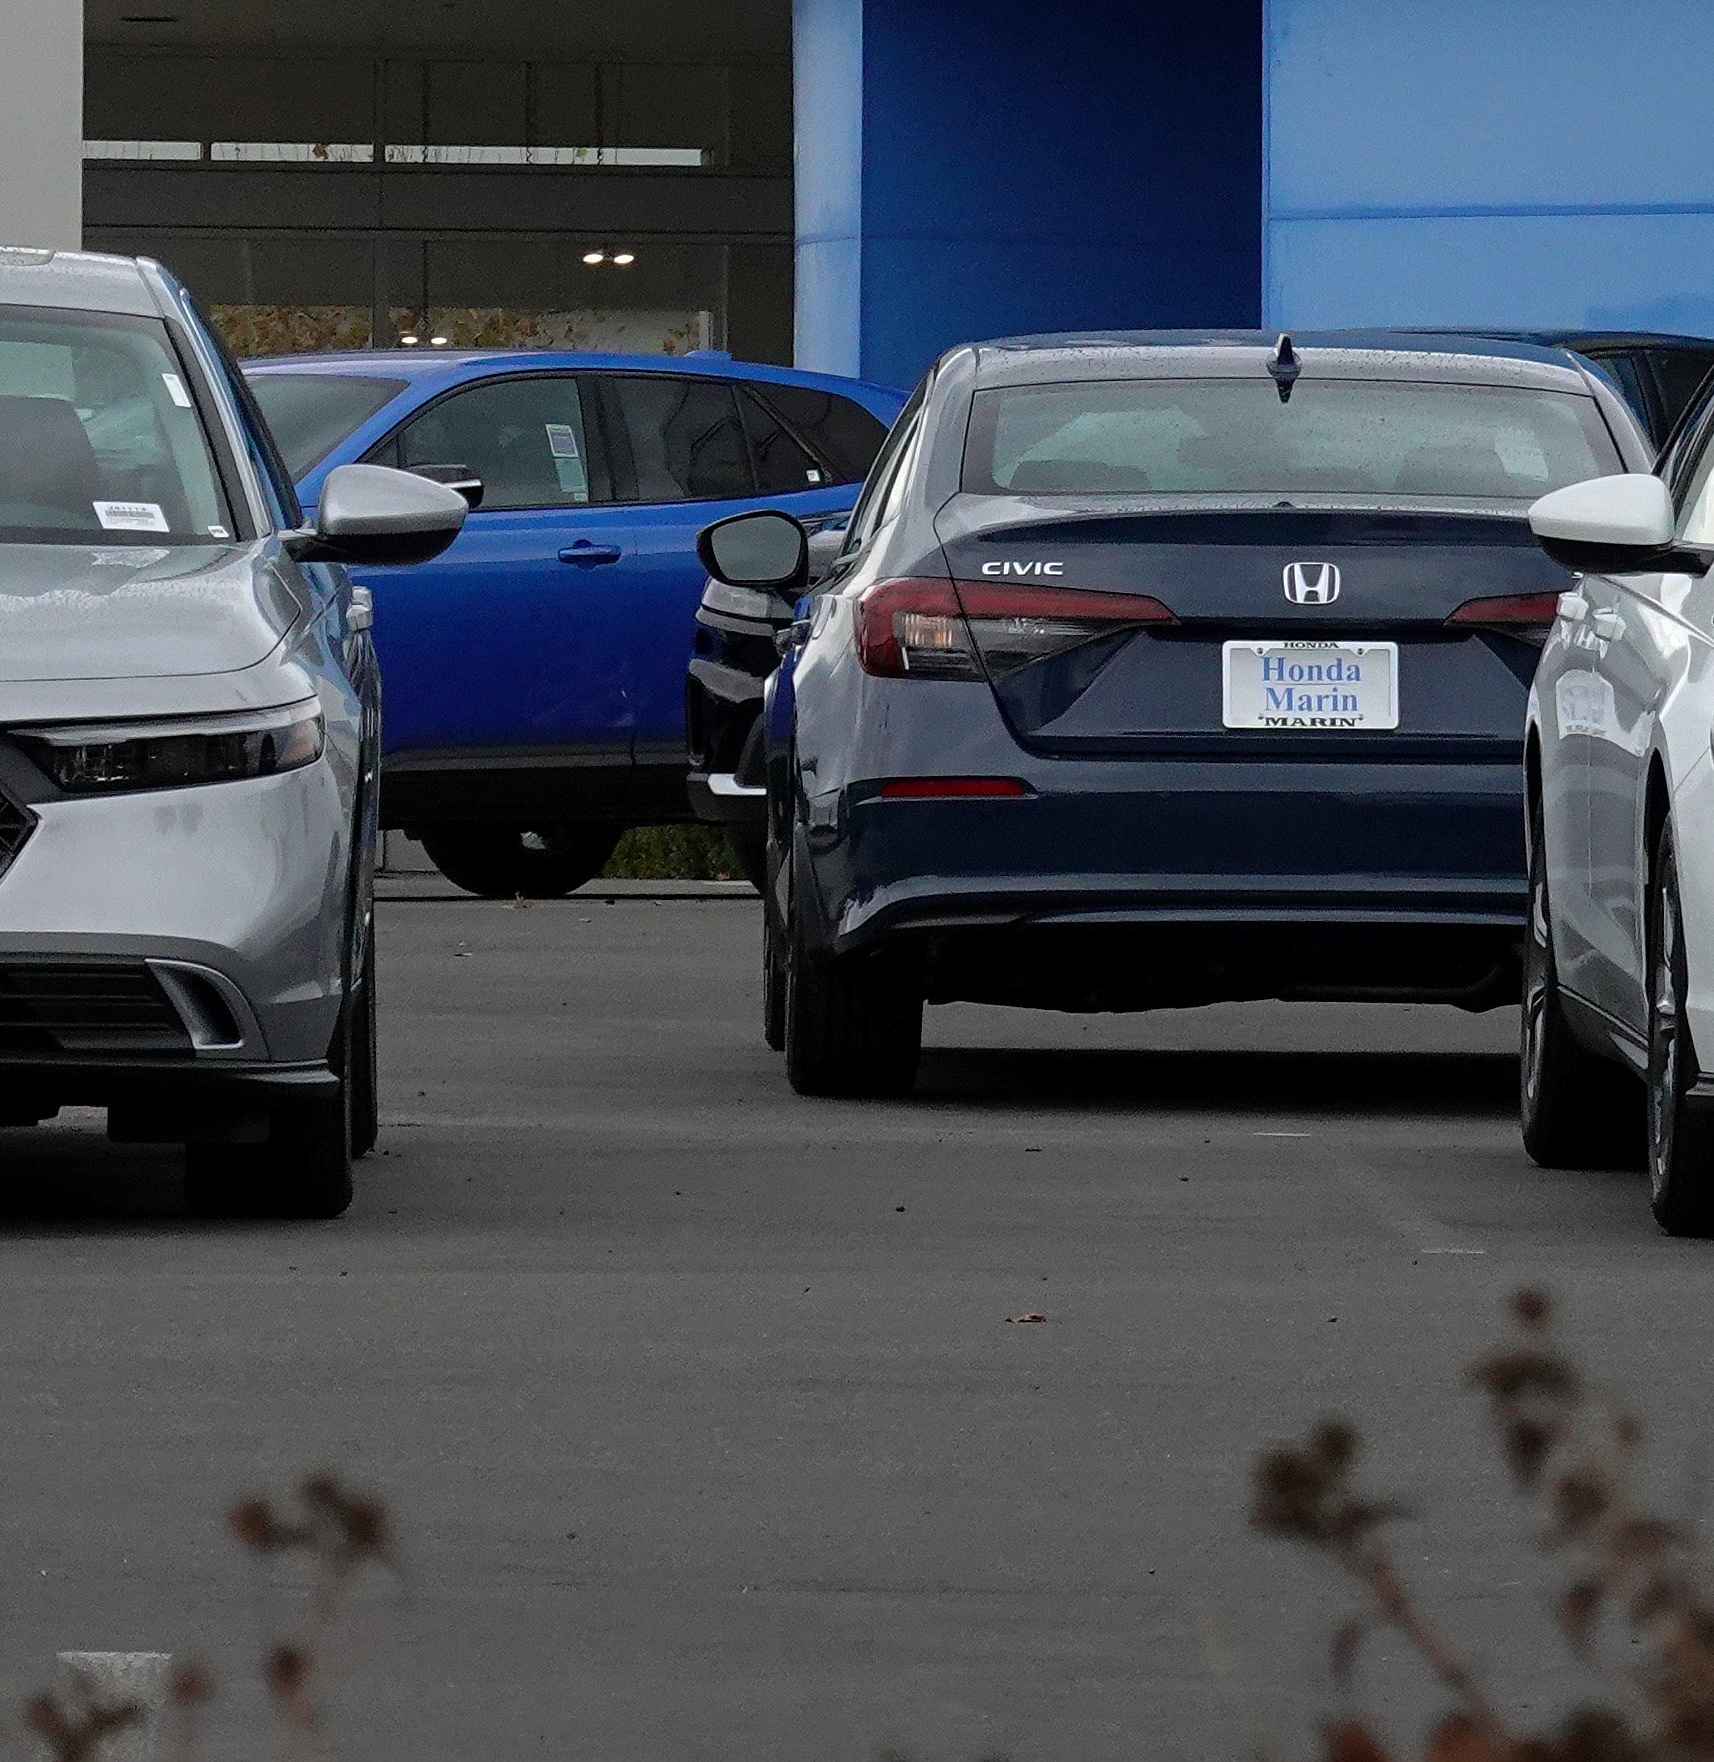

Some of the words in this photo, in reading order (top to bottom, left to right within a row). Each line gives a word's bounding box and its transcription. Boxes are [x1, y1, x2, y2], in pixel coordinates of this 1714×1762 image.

[981, 561, 1064, 576] CIVIC
[1283, 641, 1340, 649] HONDA
[1261, 656, 1362, 683] Honda
[1264, 687, 1359, 712] Marin
[1263, 716, 1357, 728] MARIN
